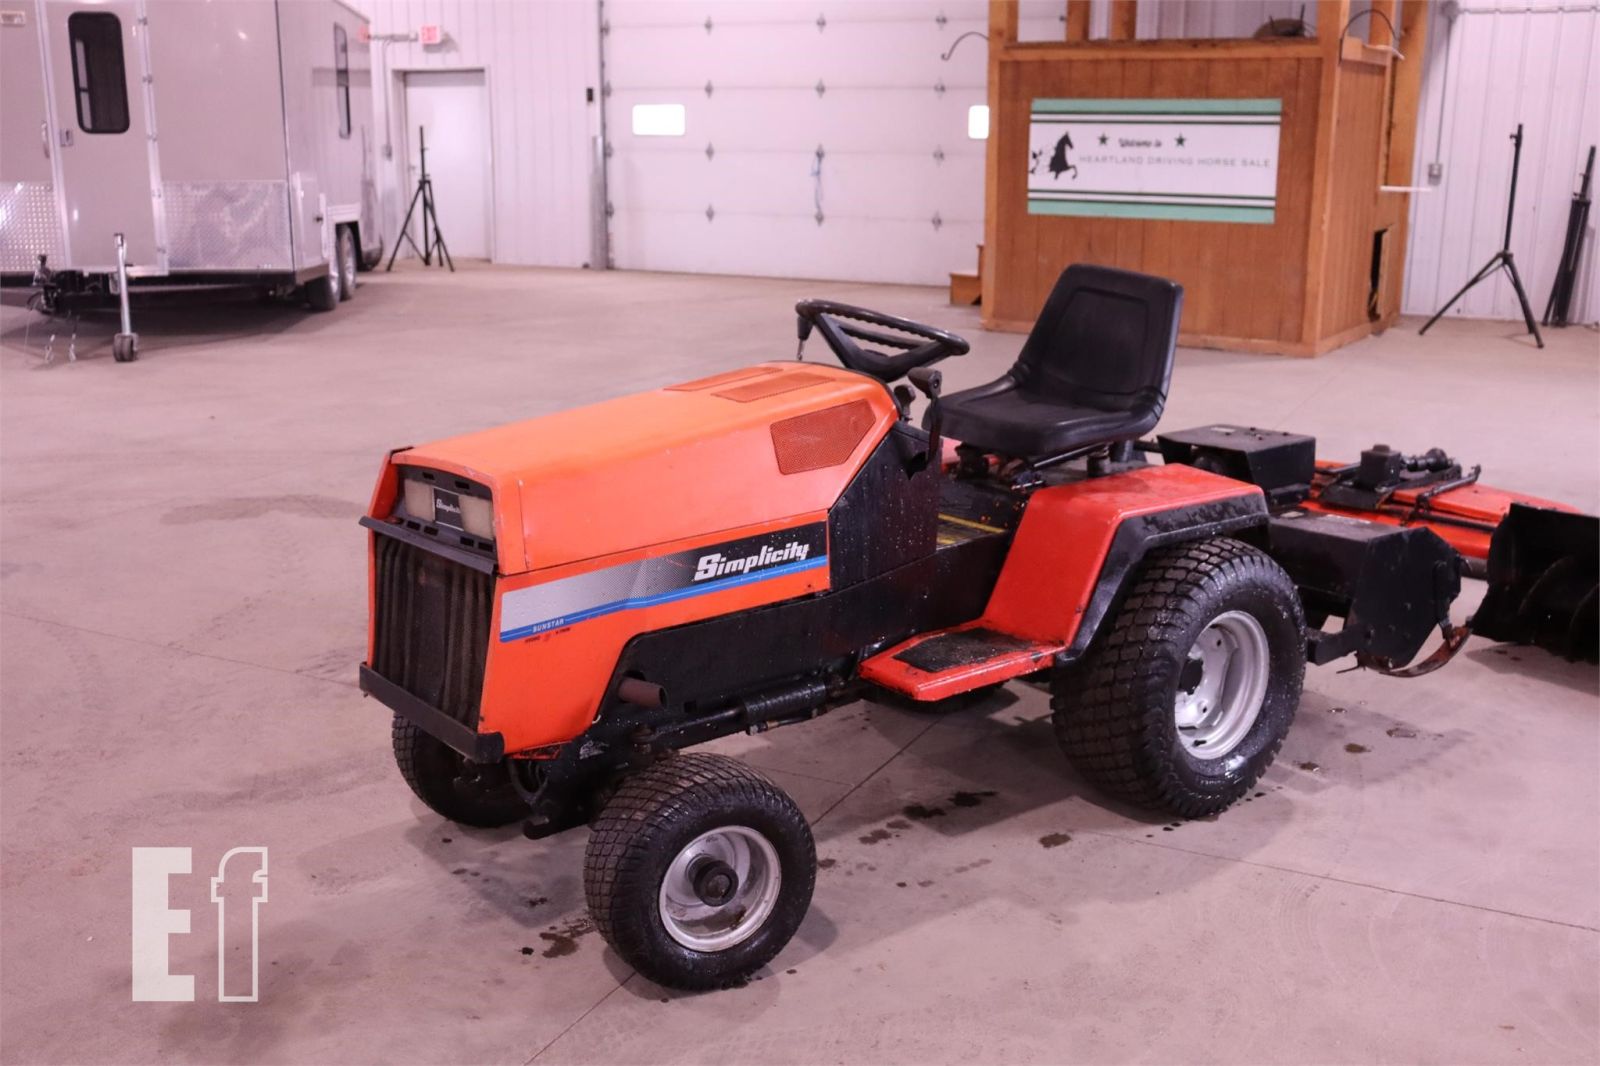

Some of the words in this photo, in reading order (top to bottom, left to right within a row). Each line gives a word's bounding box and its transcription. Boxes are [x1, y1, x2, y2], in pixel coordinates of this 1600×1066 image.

[1079, 155, 1144, 166] HEARTLAND
[1147, 156, 1194, 167] DRIVING
[1198, 157, 1237, 168] HORSE
[1241, 158, 1271, 169] SALE
[694, 541, 810, 581] Simplicity
